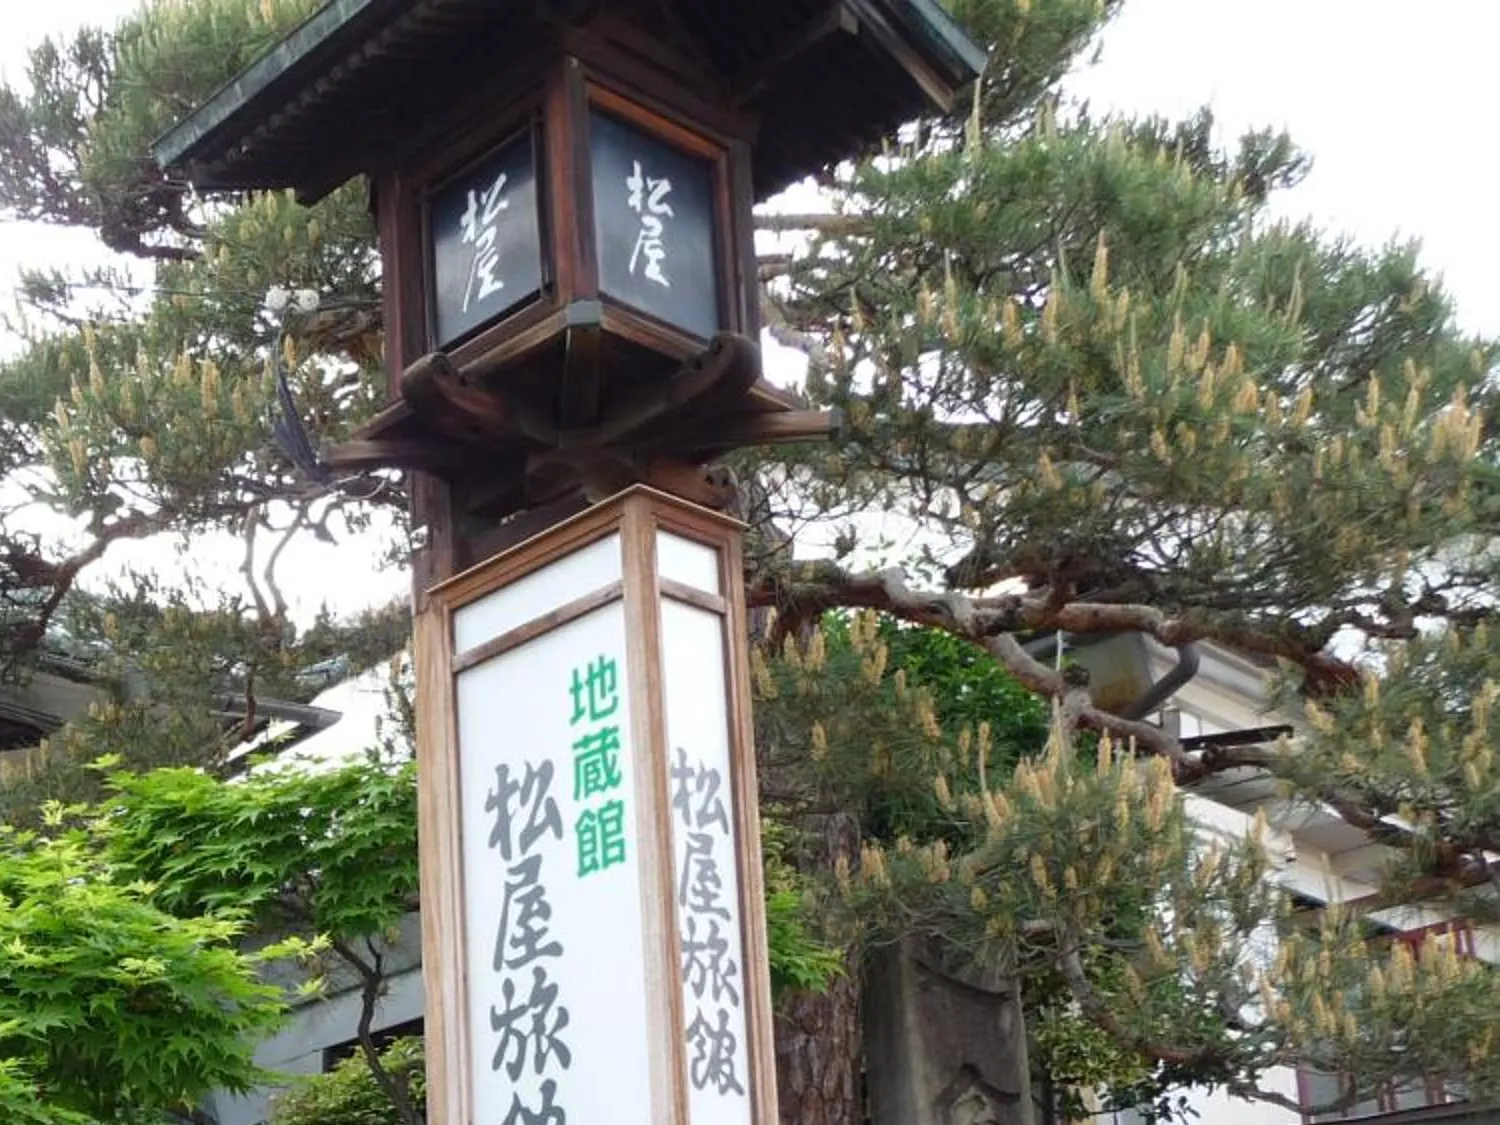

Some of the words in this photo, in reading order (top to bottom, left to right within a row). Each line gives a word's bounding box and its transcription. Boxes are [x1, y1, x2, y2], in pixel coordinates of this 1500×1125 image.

[459, 172, 510, 314] 松屋
[625, 159, 675, 288] 松屋
[569, 655, 626, 880] 地蔵館
[671, 747, 744, 1097] 松屋旅館
